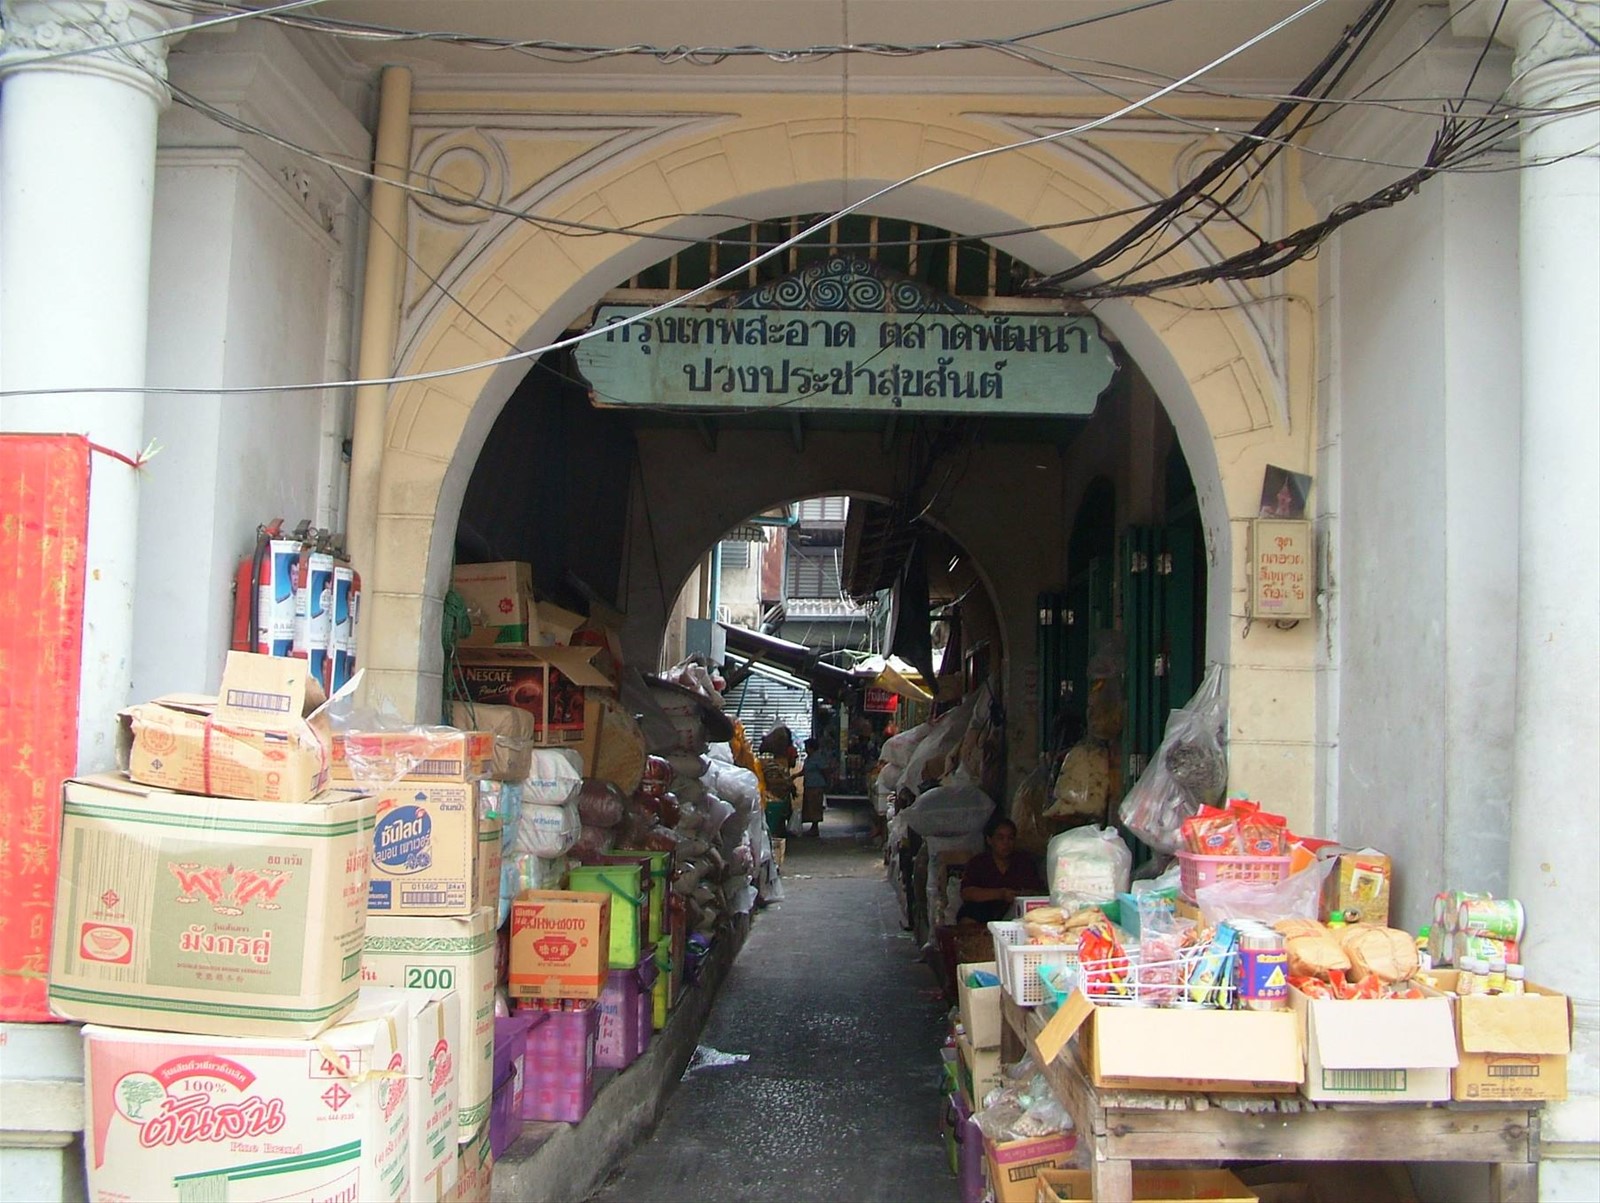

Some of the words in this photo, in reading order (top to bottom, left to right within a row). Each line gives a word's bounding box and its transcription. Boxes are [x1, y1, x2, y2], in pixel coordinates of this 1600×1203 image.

[606, 313, 857, 355] กรุงเทพสะอาด
[879, 316, 1089, 354] ตลาดพัฒนา
[682, 355, 1008, 408] ปวงประชาสุขสันต์
[466, 668, 513, 682] NESCAFÉ
[181, 924, 271, 964] มังกรคู่
[408, 967, 452, 989] 200
[184, 1079, 227, 1093] 100%
[142, 1092, 285, 1148] ต้นสน
